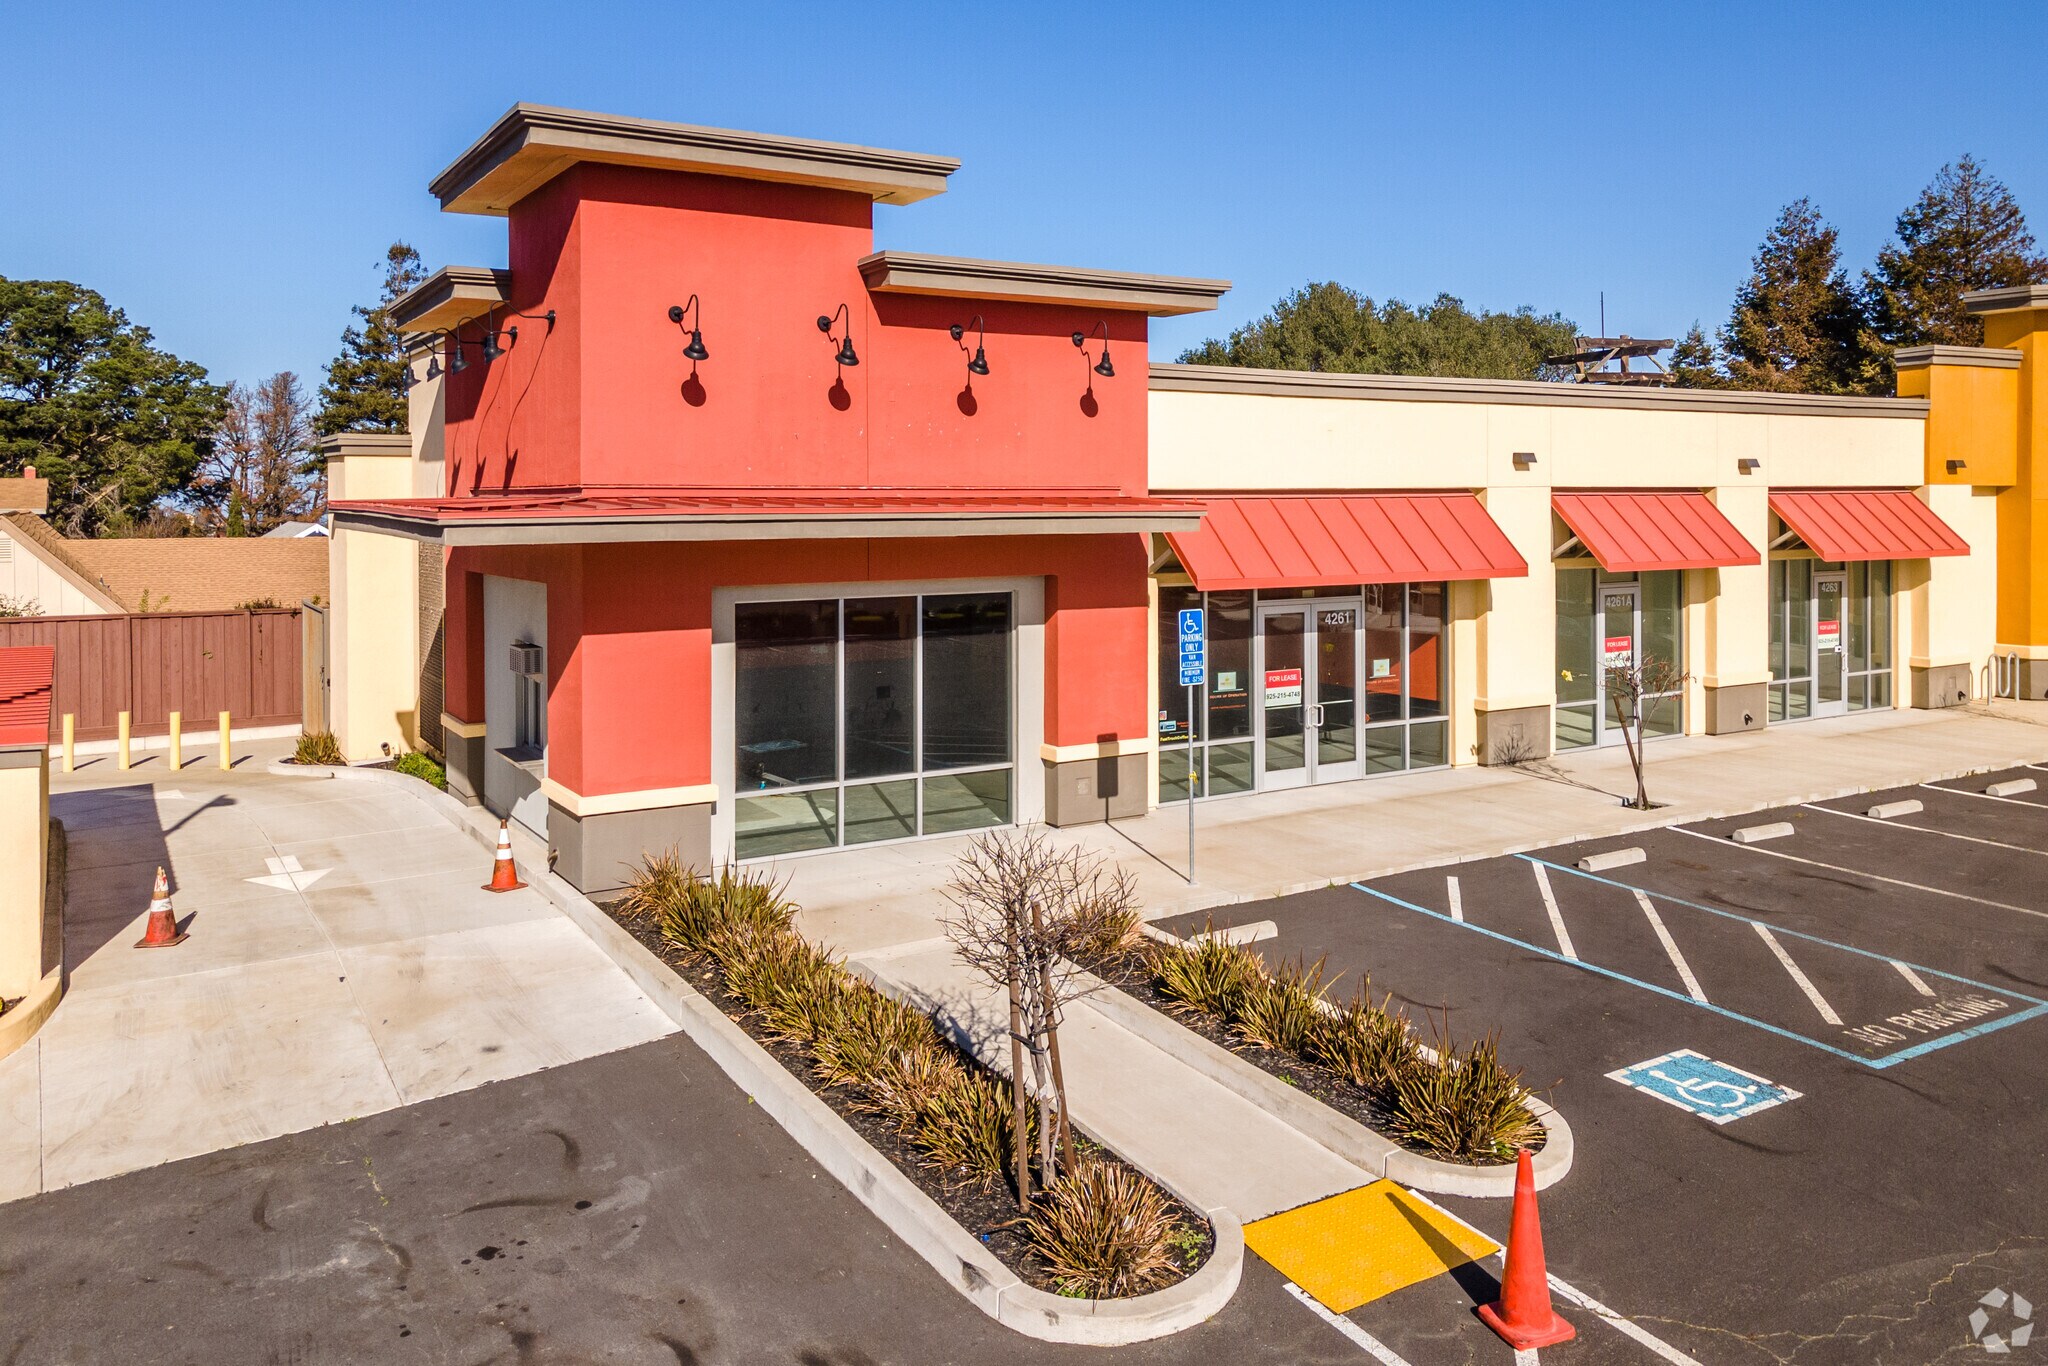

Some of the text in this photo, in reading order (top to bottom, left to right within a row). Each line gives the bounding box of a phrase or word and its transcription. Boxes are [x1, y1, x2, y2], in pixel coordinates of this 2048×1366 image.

[1821, 583, 1838, 593] 4263
[1605, 596, 1633, 607] 4261A
[1325, 612, 1350, 625] 4261
[1181, 633, 1202, 643] PARKING
[1185, 643, 1199, 652] ONLY
[1842, 993, 2009, 1047] NO PARKING
